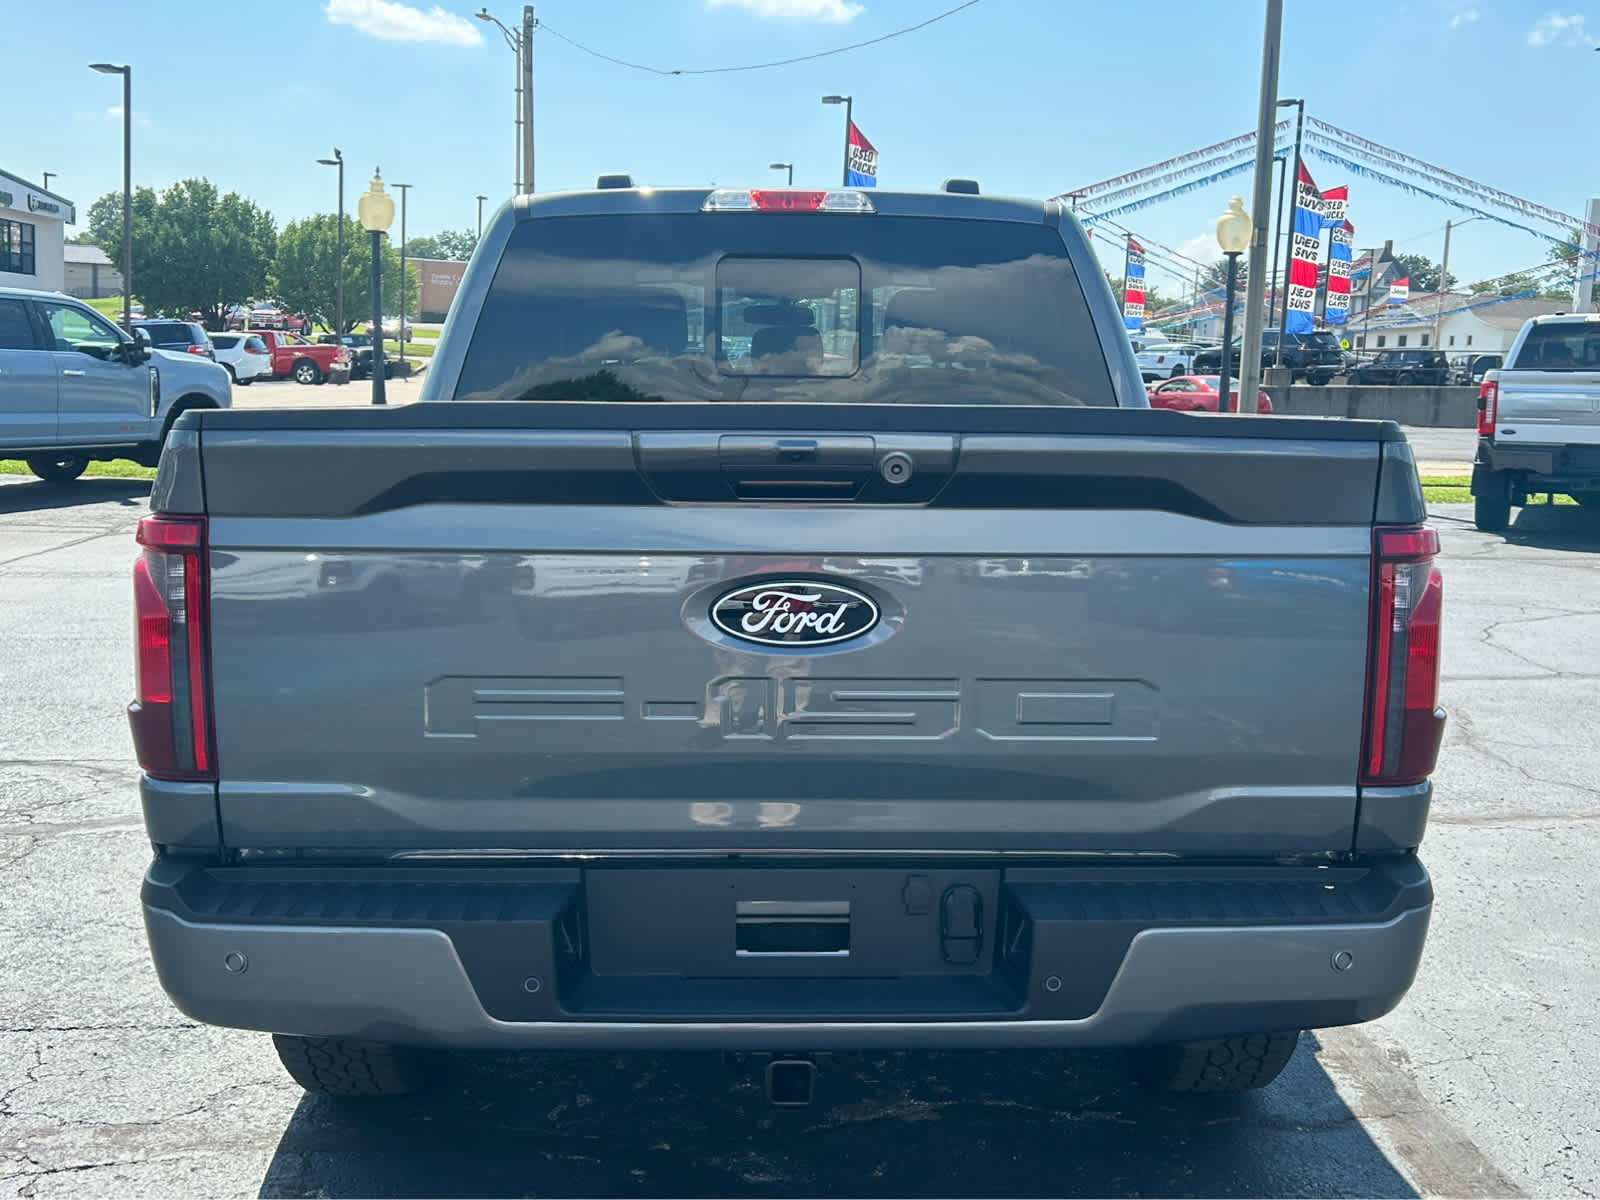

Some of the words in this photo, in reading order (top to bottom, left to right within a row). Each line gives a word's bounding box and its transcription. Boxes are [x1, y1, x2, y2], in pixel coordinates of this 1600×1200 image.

[853, 147, 874, 162] USED
[848, 157, 877, 176] TRUCKS
[1299, 183, 1322, 200] USE
[1326, 200, 1343, 210] SED
[1325, 211, 1345, 219] UCKS
[741, 591, 848, 634] Ford
[424, 675, 1160, 740] F-150
